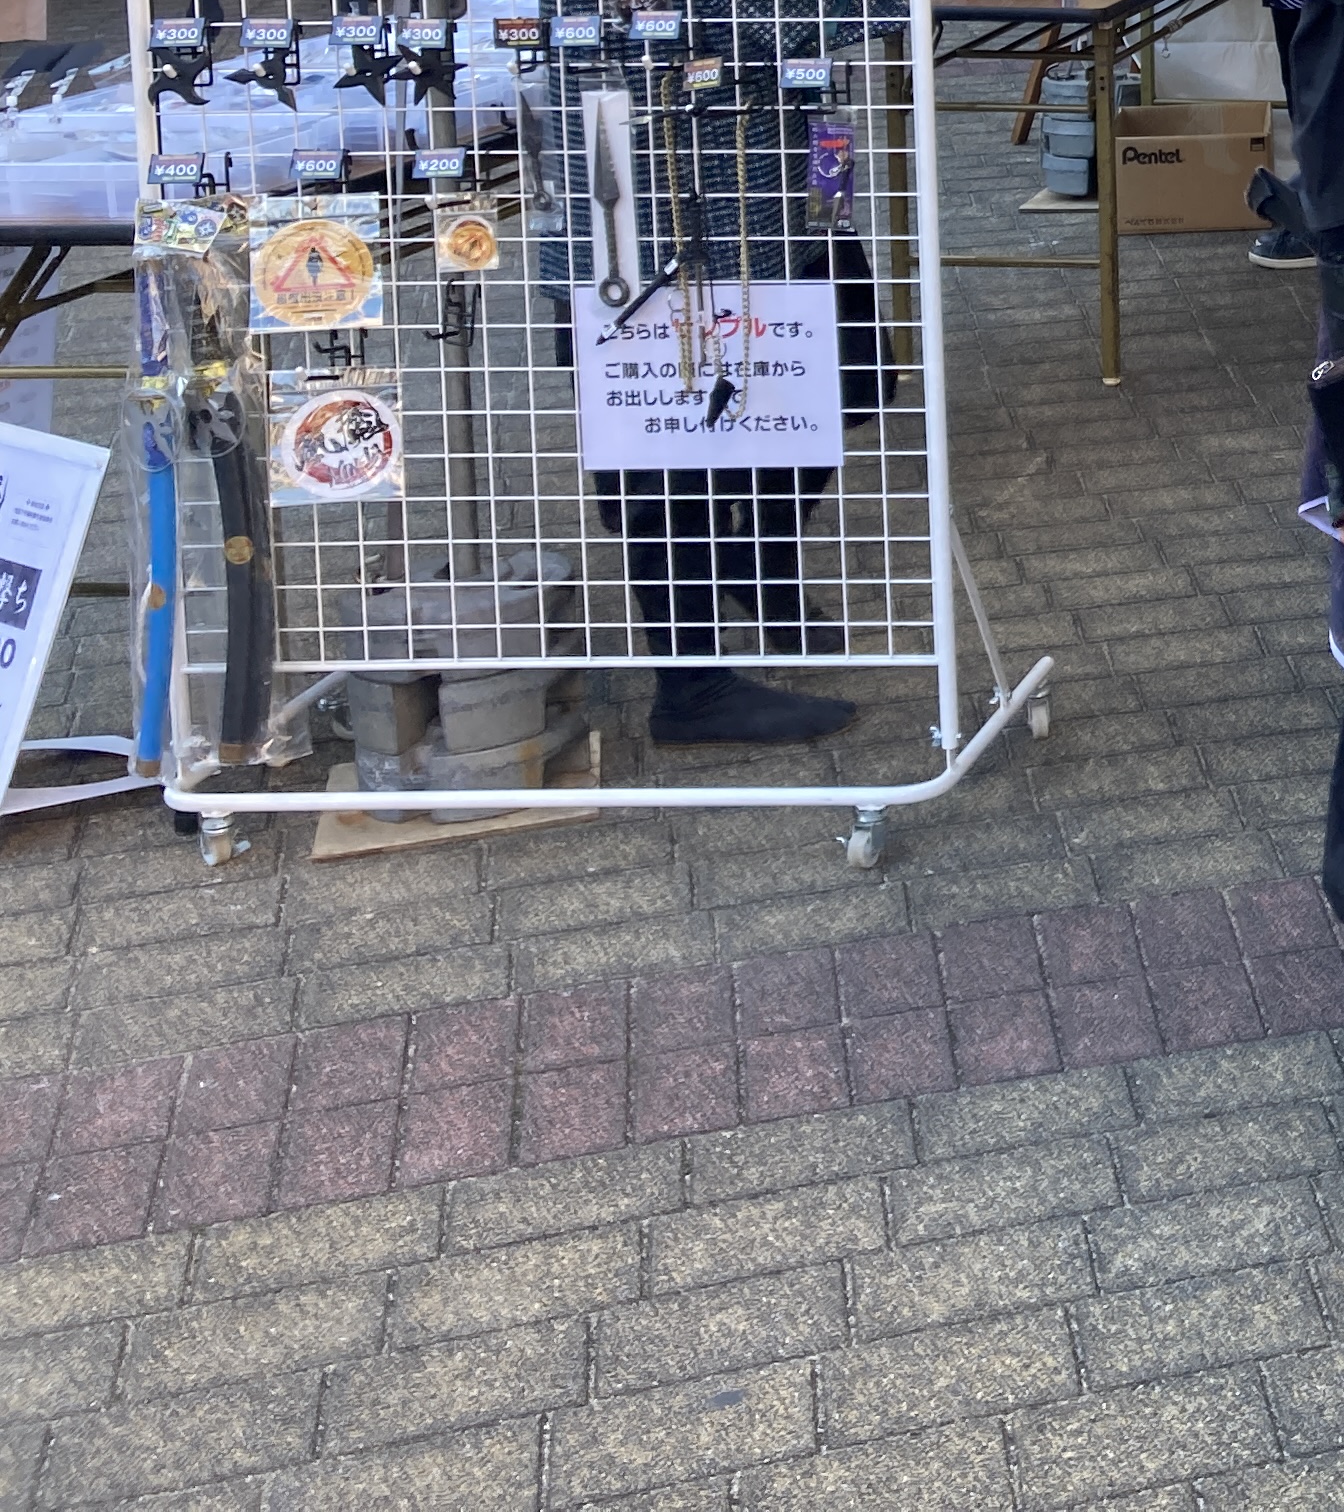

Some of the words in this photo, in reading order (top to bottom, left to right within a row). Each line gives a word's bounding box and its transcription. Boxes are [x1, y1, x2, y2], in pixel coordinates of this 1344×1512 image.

[336, 26, 377, 38] ¥300
[635, 19, 676, 32] ¥600
[156, 28, 198, 40] ¥300
[246, 28, 288, 40] ¥300
[402, 28, 442, 40] ¥300
[498, 28, 539, 41] ¥300
[555, 27, 596, 39] ¥600
[785, 68, 826, 81] ¥500
[1122, 146, 1183, 165] Pentel
[154, 164, 198, 176] ¥400
[295, 159, 337, 172] ¥600
[418, 158, 460, 171] ¥200
[606, 390, 744, 407] お出ししますで
